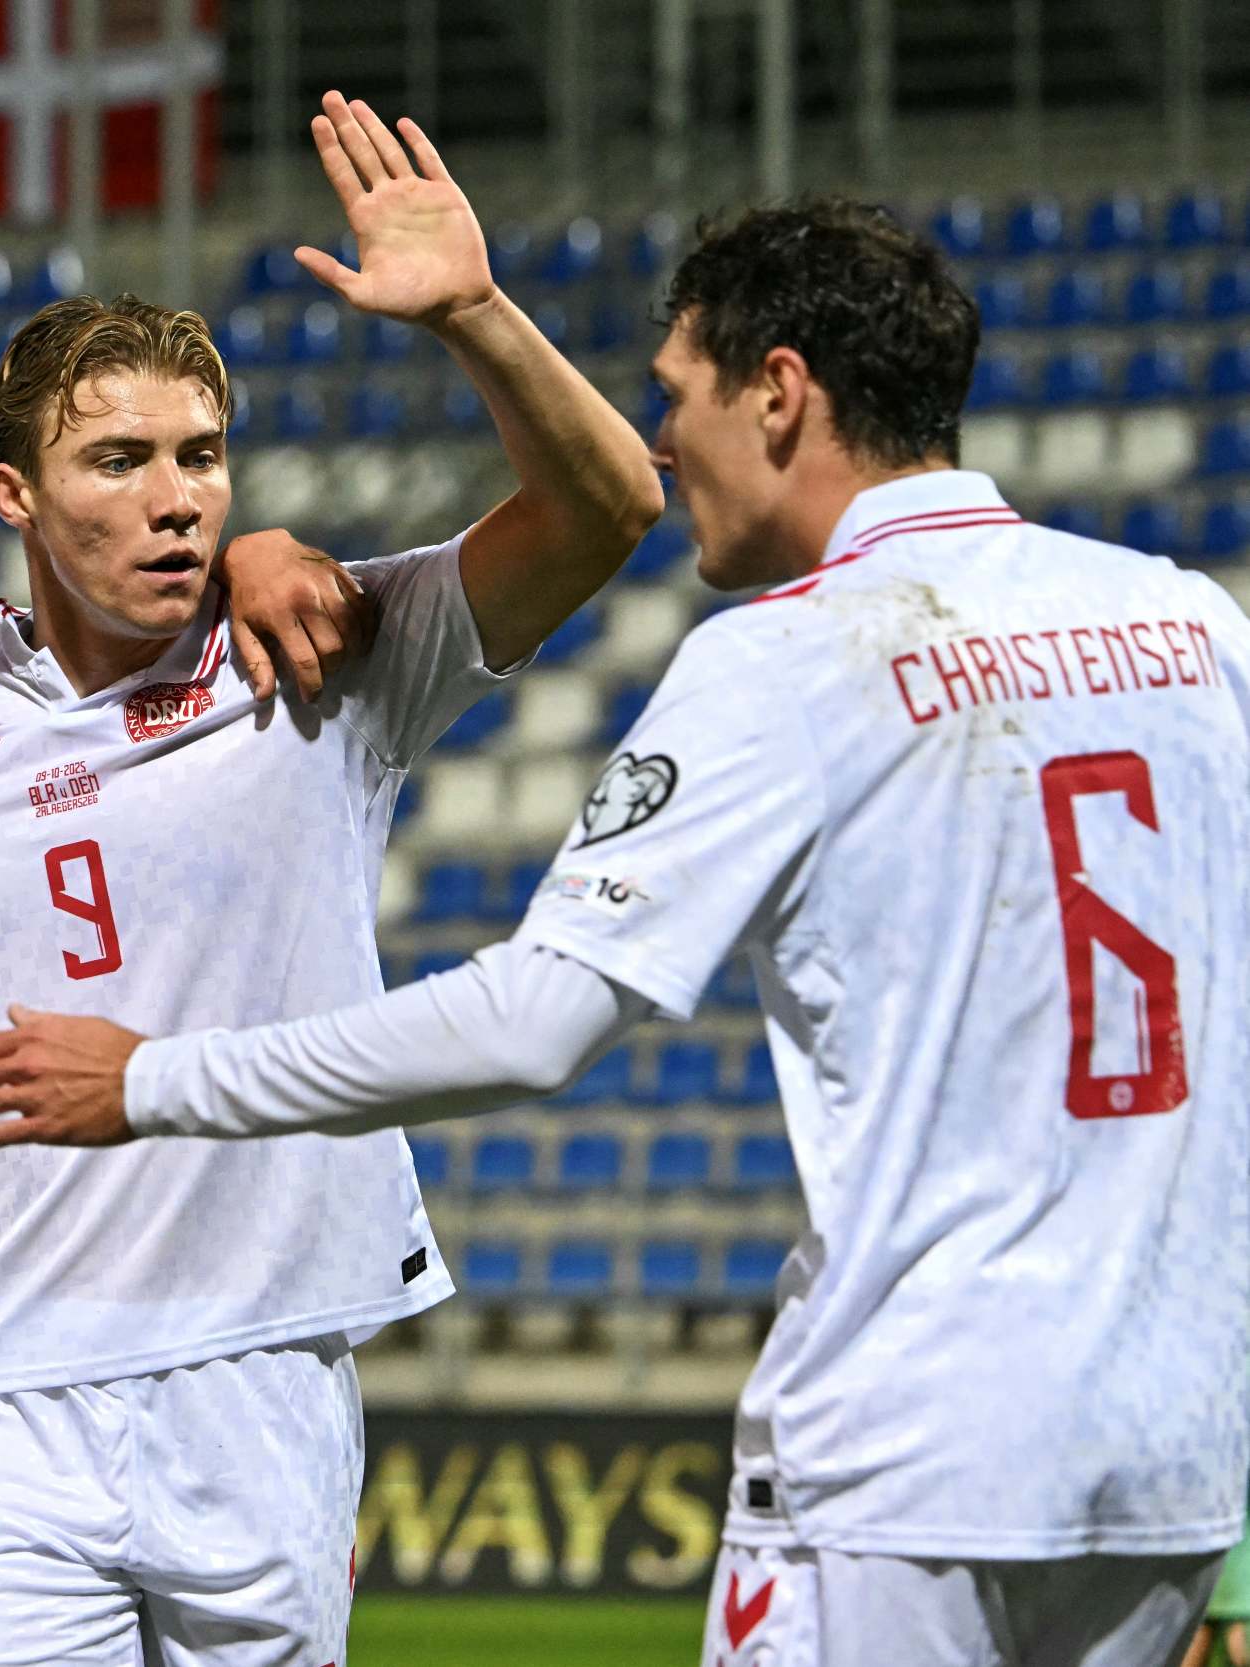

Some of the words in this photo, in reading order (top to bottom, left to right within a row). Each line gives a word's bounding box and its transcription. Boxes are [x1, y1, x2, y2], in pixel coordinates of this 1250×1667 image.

[891, 620, 1222, 724] CHRISTENSEN
[144, 699, 196, 727] DBU
[35, 760, 87, 782] 09-10-2025
[28, 782, 57, 806] BLR
[69, 773, 100, 797] DEN
[35, 793, 98, 817] ZALAEGERSZEG
[44, 839, 122, 980] 9
[1040, 749, 1189, 1120] 6
